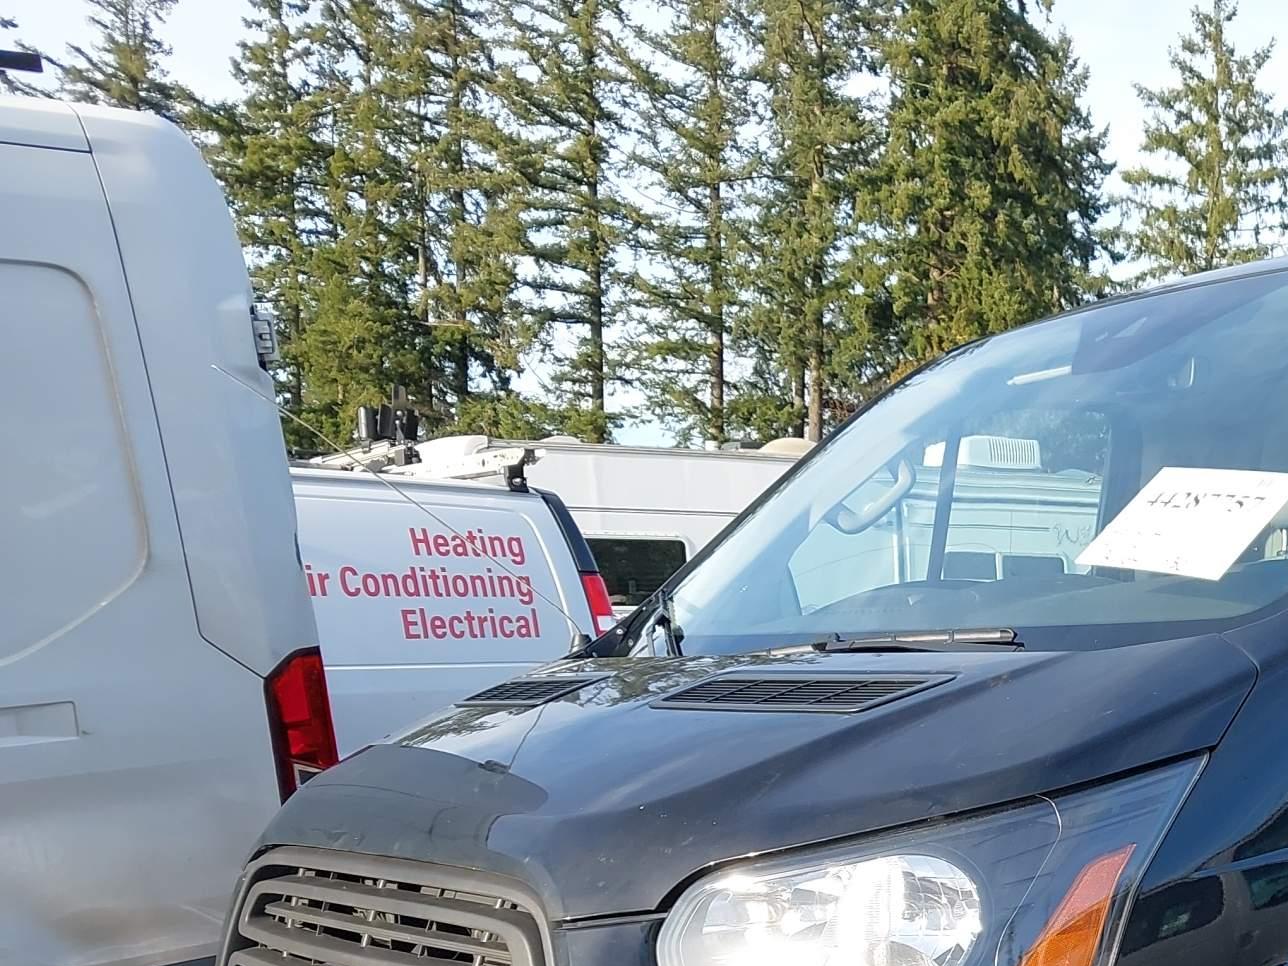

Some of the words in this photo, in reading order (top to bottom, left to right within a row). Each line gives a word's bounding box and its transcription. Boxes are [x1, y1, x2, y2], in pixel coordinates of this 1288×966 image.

[409, 527, 526, 565] Heating
[304, 564, 330, 597] ir
[339, 566, 534, 605] Conditioning
[401, 608, 541, 640] Electrical
